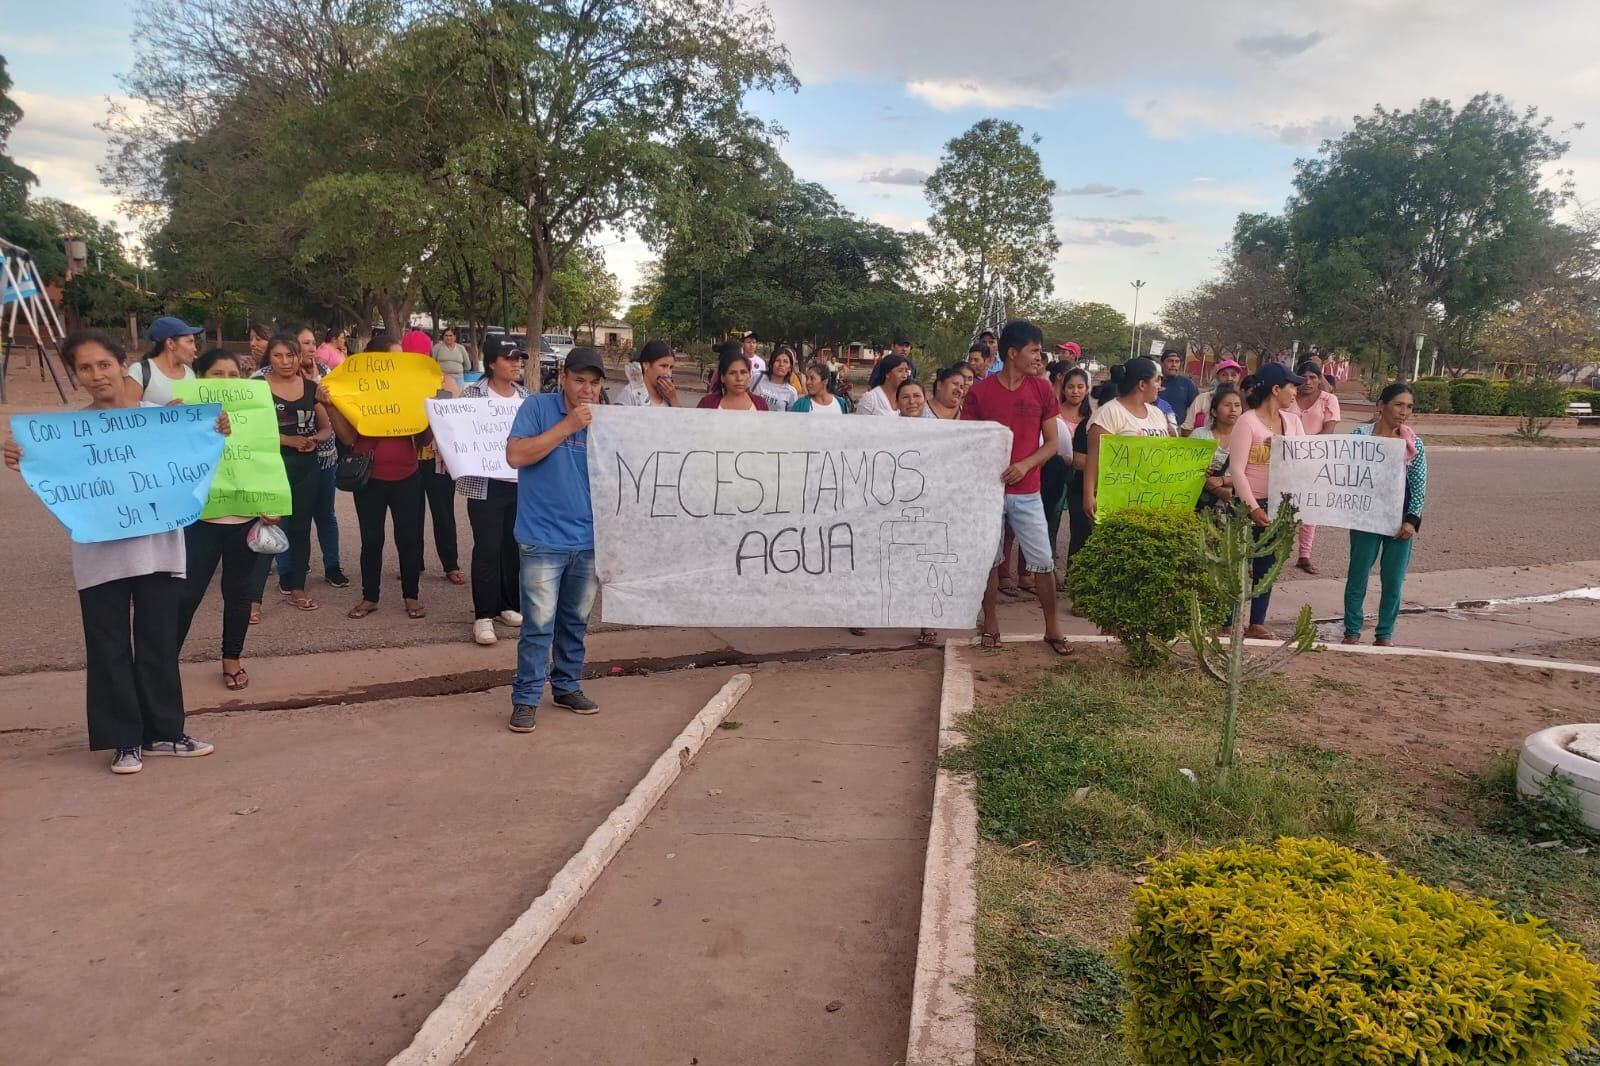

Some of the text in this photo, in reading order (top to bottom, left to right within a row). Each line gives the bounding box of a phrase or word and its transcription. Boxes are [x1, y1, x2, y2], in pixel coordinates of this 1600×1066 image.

[347, 356, 394, 372] EL AGUA
[198, 385, 254, 403] QUEREMOS
[358, 378, 389, 391] ES UN
[359, 402, 401, 416] ERECHO
[29, 409, 203, 443] CON LA SALUD NO SE
[83, 444, 137, 466] JUEGA
[473, 441, 480, 453] A
[1109, 443, 1129, 468] YA
[1137, 446, 1165, 469] NO
[1282, 439, 1386, 463] NESESITAMOS
[38, 461, 210, 505] SOLUCIÓN DEL AGUA
[1313, 463, 1374, 489] AGUA
[1127, 490, 1192, 510] HECHOS
[1306, 492, 1321, 507] EL
[1326, 492, 1372, 512] BARRIO
[736, 522, 855, 576] AGUA
